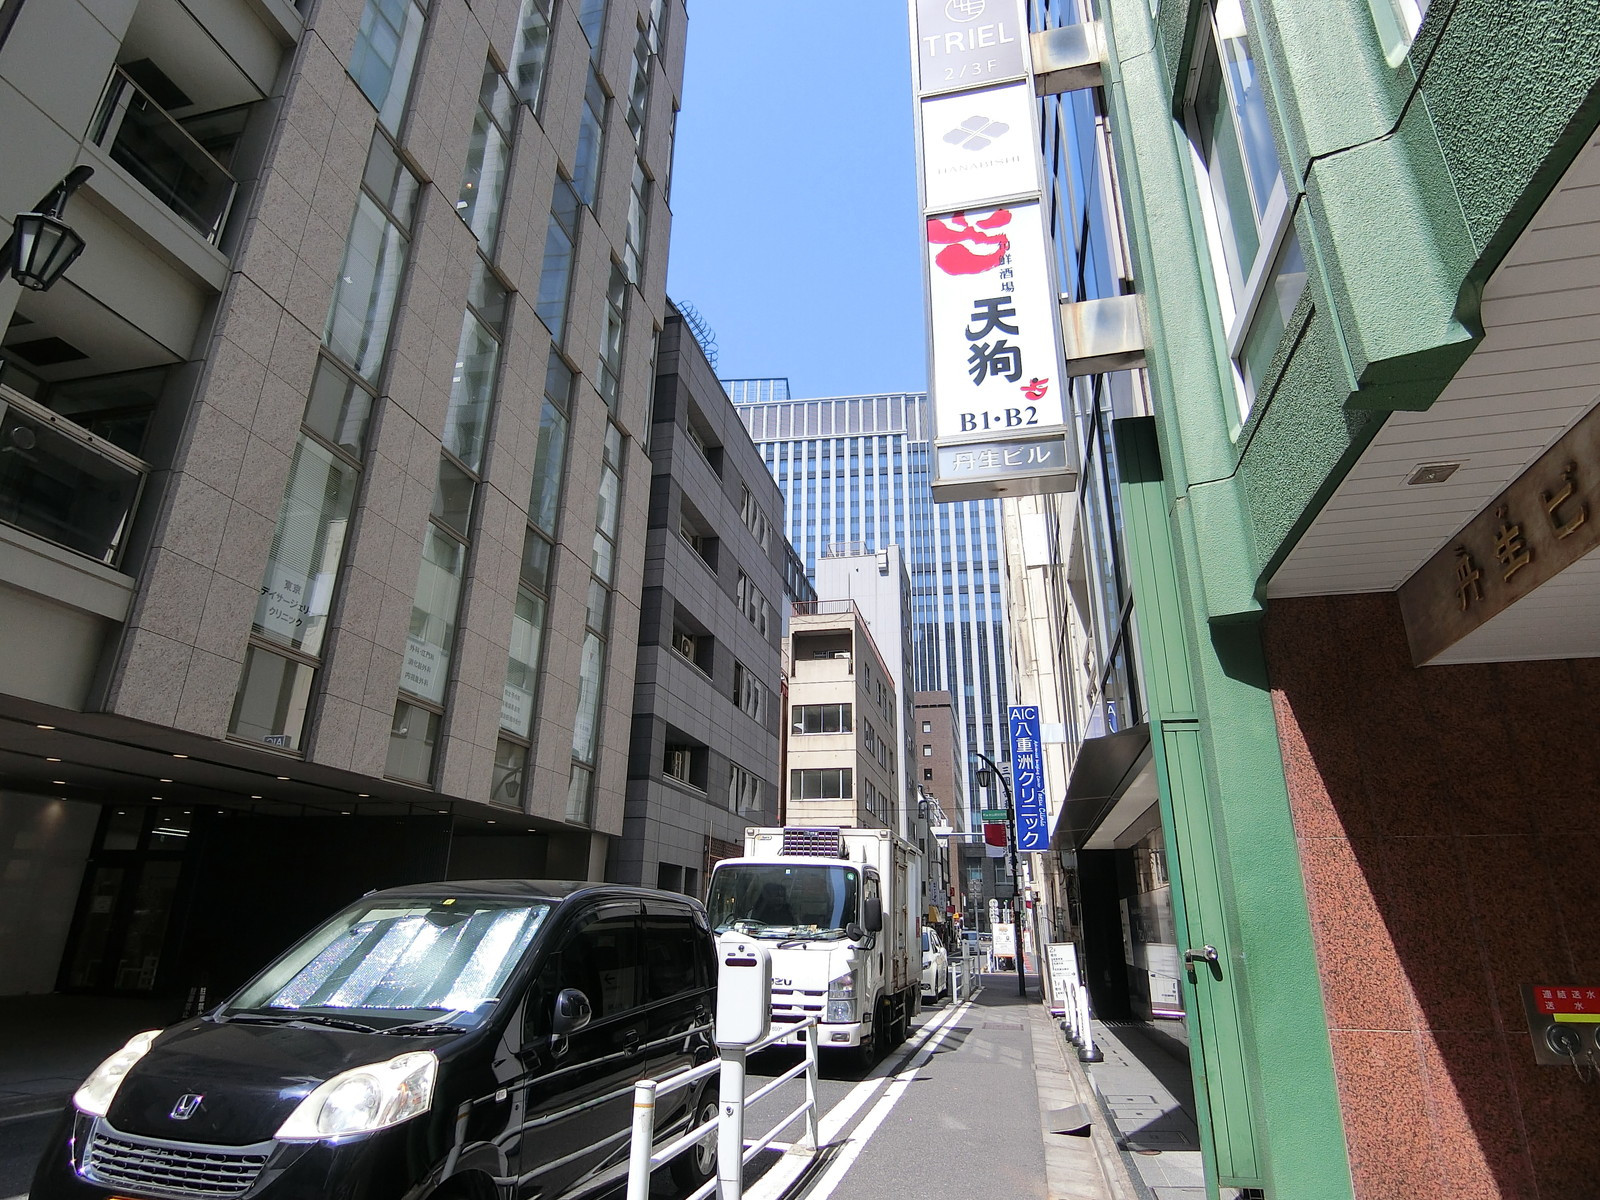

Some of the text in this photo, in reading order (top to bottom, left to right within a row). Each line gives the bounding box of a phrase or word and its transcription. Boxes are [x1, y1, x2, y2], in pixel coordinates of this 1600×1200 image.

[923, 22, 1015, 58] TRIEL
[943, 59, 998, 81] 2/3F
[965, 295, 1023, 387] 天狗
[952, 445, 1051, 472] 丹生ビル
[1011, 708, 1035, 721] AIC
[1014, 721, 1039, 848] 八重洲クリニック
